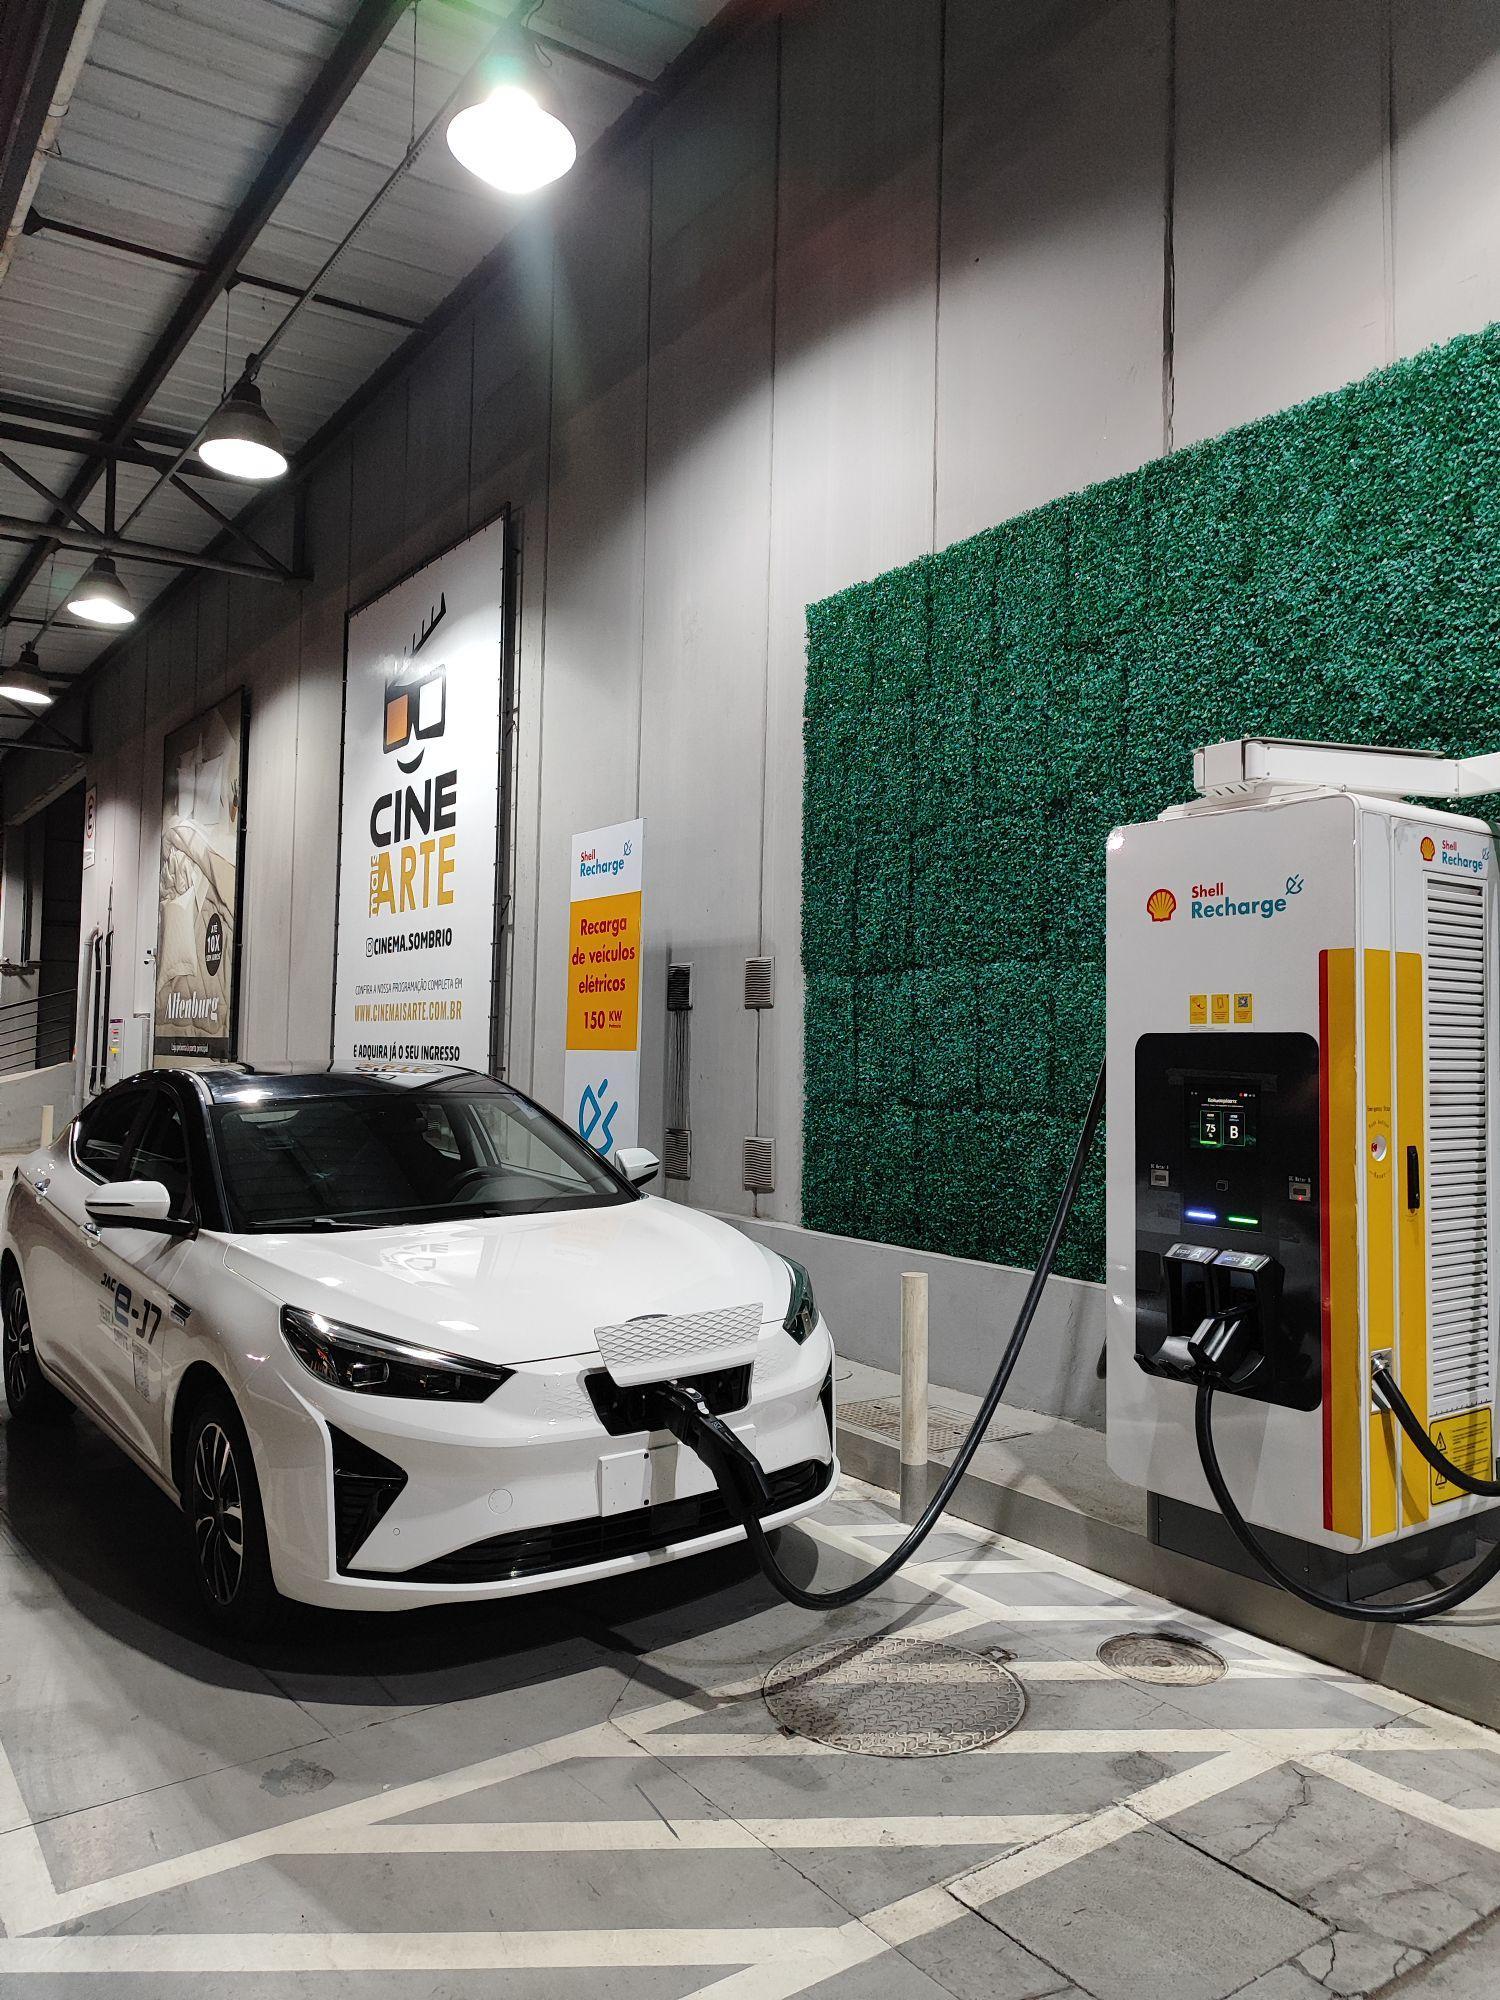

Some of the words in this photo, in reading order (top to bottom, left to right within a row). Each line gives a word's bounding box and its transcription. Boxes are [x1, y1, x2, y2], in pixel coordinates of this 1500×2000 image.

[370, 769, 457, 847] CINE
[1442, 840, 1457, 851] Shell
[580, 849, 595, 862] Shell
[1442, 852, 1483, 873] Recharge
[369, 833, 455, 918] ARTE
[580, 859, 624, 877] Recharge
[1191, 882, 1224, 899] Shell
[1191, 897, 1287, 919] Recharge
[580, 918, 627, 937] Recarga
[208, 934, 220, 953] 10X
[572, 946, 586, 966] de
[589, 941, 635, 963] veículos
[428, 978, 453, 991] COMPLETA
[454, 977, 462, 989] EM
[579, 973, 626, 994] elétricos
[165, 991, 219, 1021] Altenburg
[354, 1001, 462, 1022] WWW.CINEMAISARTE.COM.BR
[584, 1010, 605, 1029] 150
[608, 1010, 622, 1021] KW
[353, 1044, 358, 1058] E
[358, 1044, 388, 1060] ADQUIRA
[389, 1041, 397, 1061] JÁ
[398, 1045, 404, 1060] O
[405, 1045, 419, 1061] SEU
[420, 1045, 460, 1061] INGRESSO
[1205, 1123, 1216, 1133] 75
[1229, 1125, 1239, 1139] B
[1241, 1256, 1255, 1266] B
[100, 1272, 117, 1292] JAC
